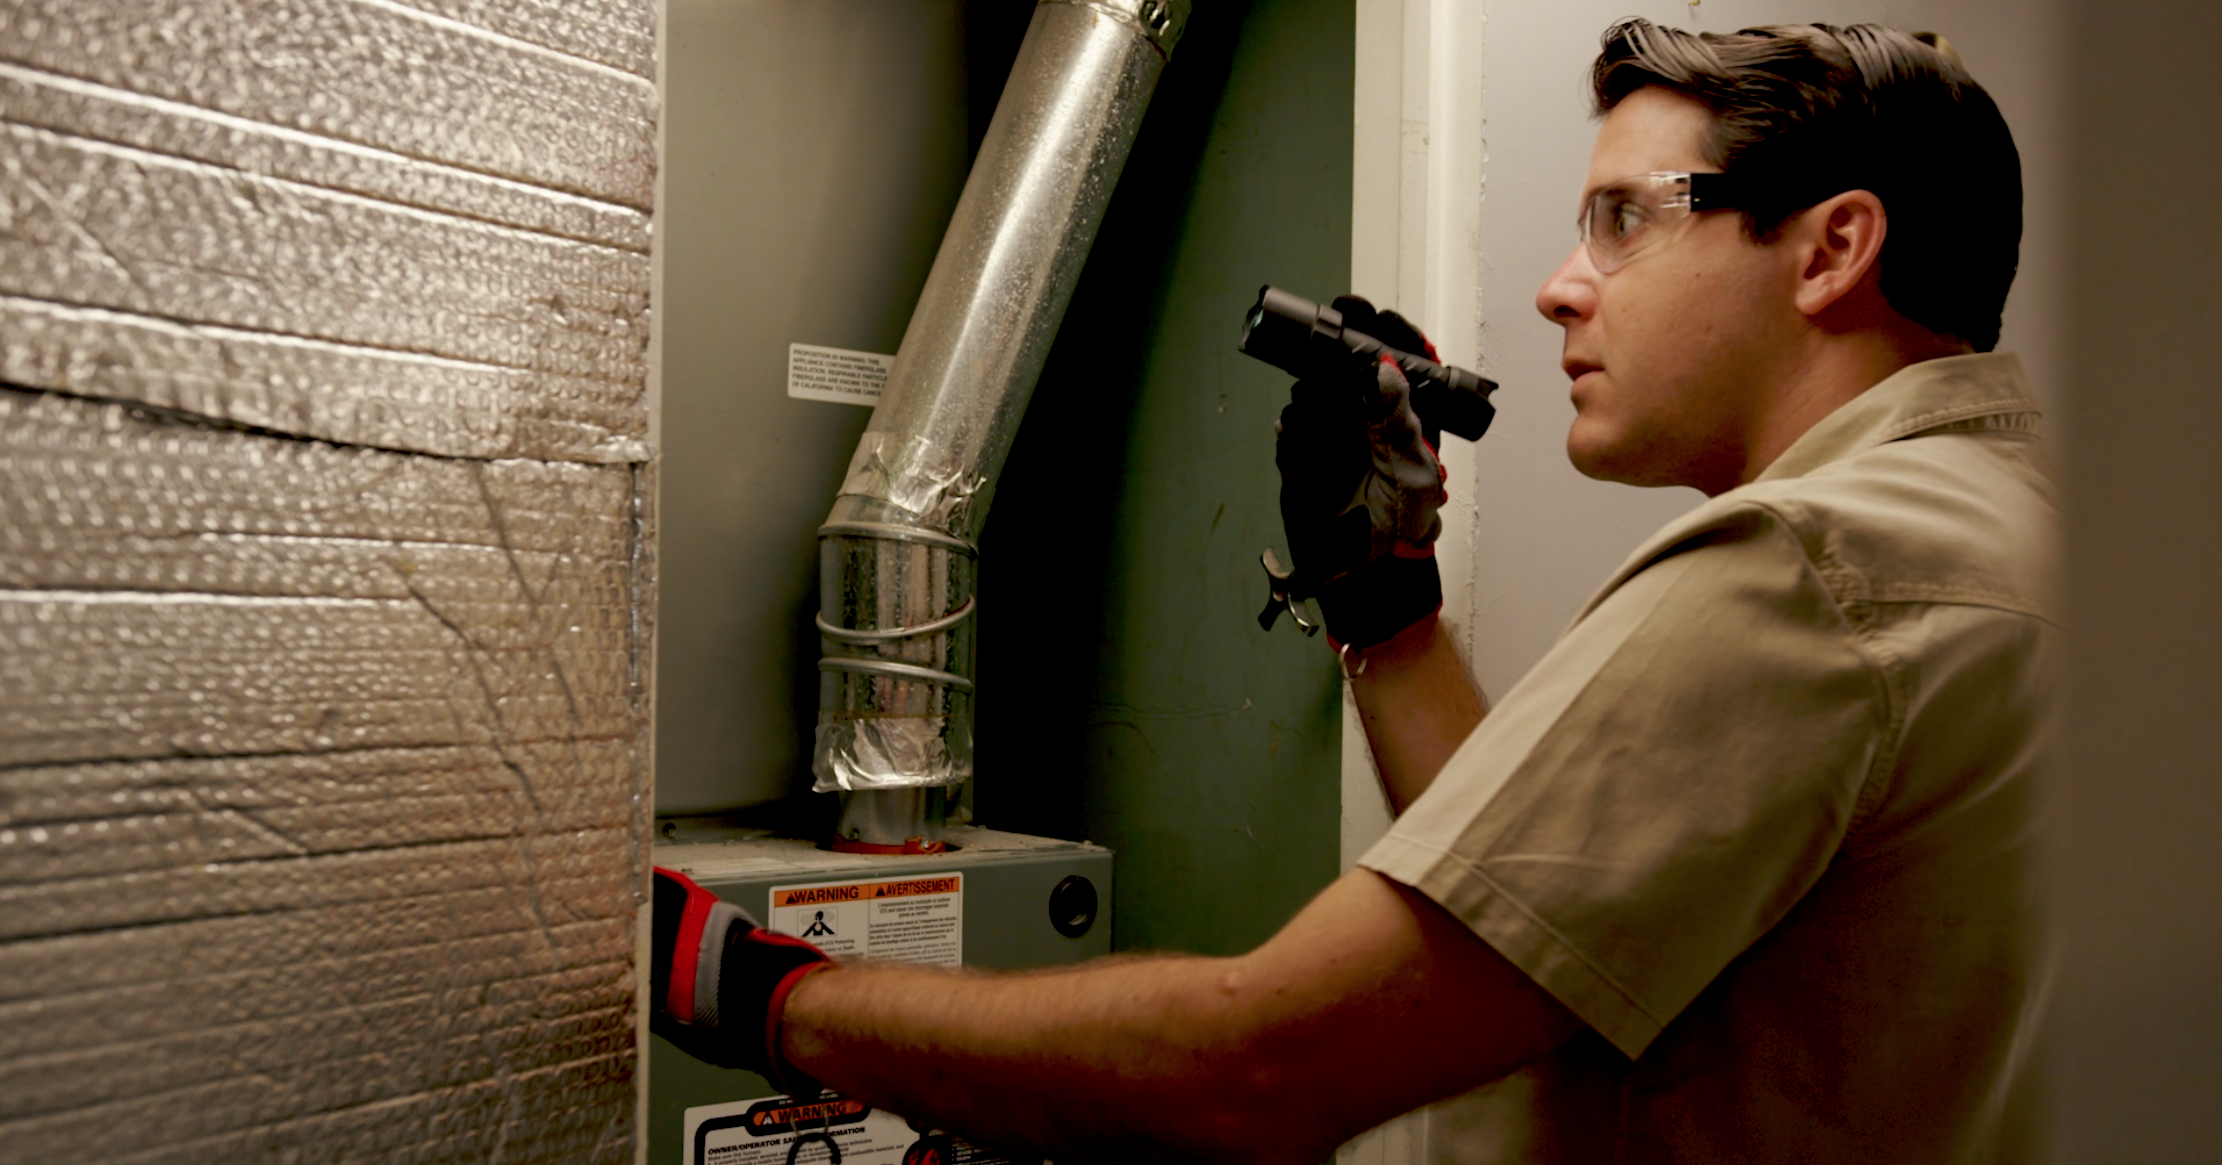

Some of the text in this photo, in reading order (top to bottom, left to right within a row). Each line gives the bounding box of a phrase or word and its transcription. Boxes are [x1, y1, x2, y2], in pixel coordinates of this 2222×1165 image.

[854, 365, 886, 373] FIBERGLASS
[793, 373, 826, 382] FIBERGLASS
[801, 382, 833, 390] CALIFORNIA
[887, 879, 954, 895] AVERTISSEMENT
[795, 887, 858, 903] WARNING
[708, 1139, 780, 1154] OWNER/OPERATOR
